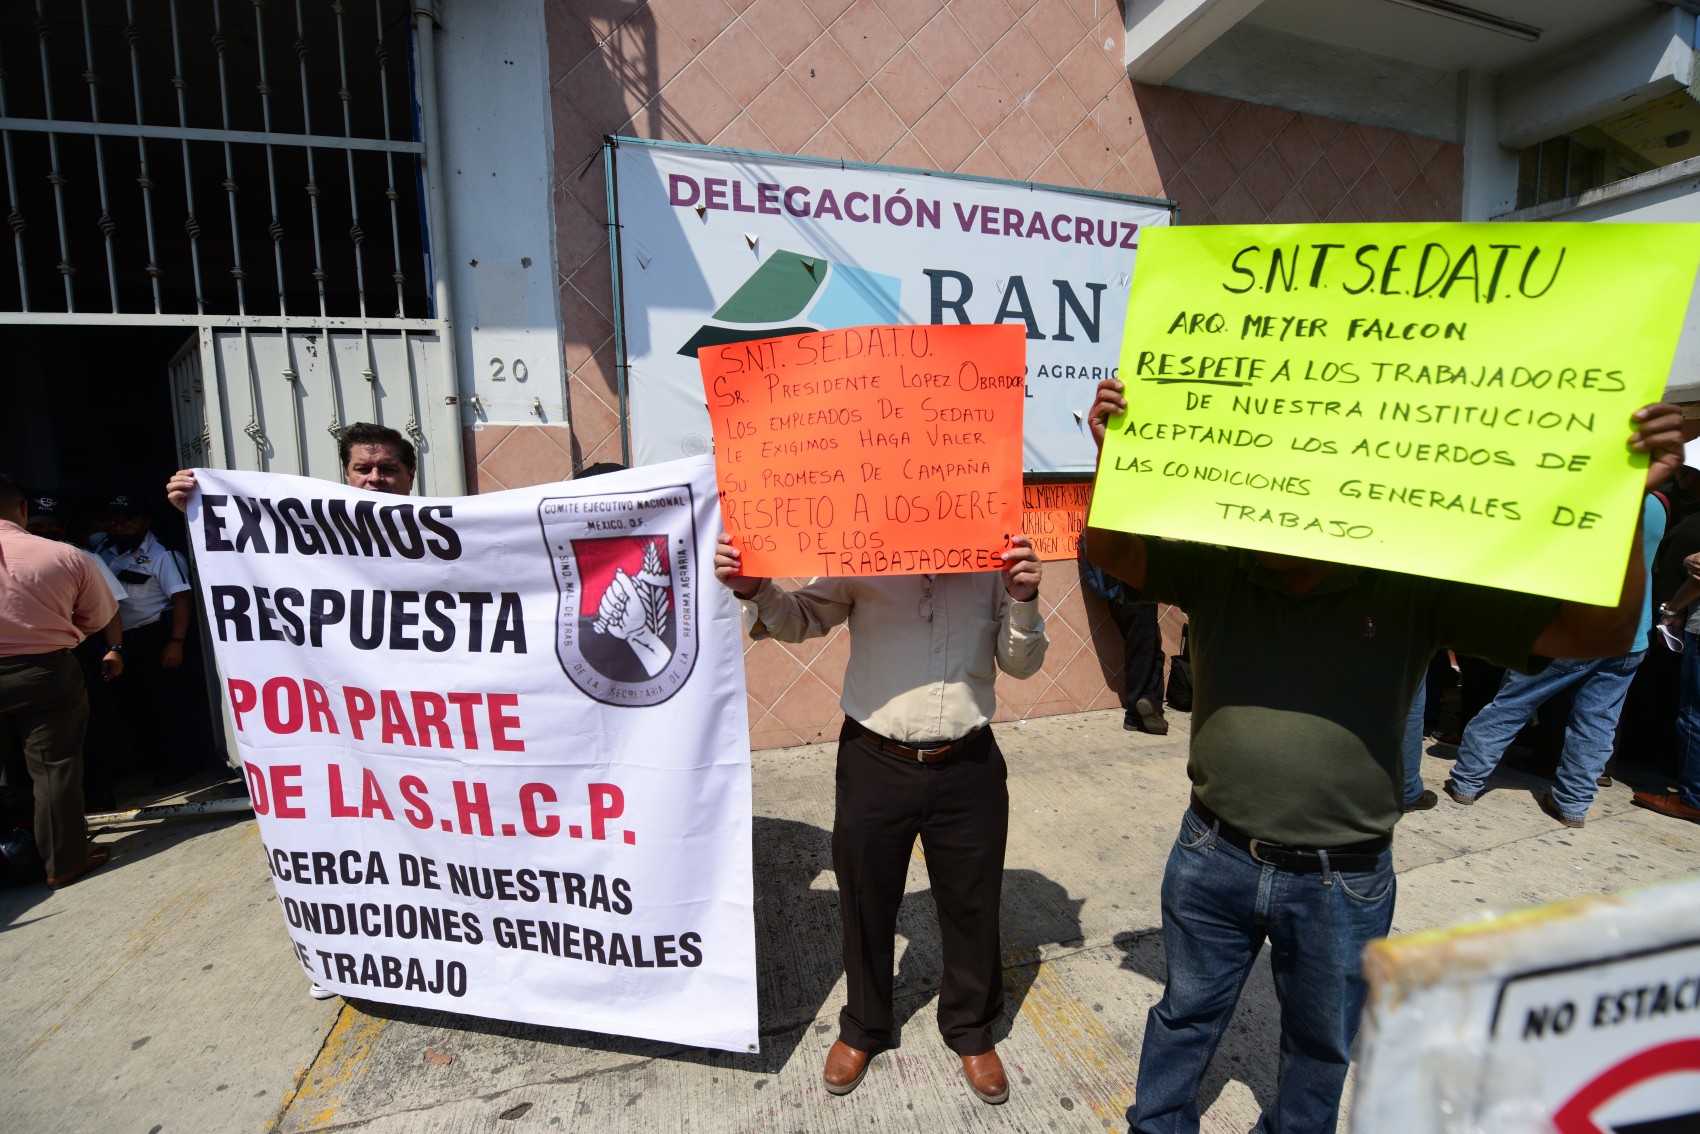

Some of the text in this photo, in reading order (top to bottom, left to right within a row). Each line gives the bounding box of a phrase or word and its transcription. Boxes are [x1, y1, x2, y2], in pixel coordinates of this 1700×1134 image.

[668, 174, 1139, 250] DELEGACIÓN VERACRUZ
[923, 268, 1107, 343] RAN
[1167, 311, 1467, 342] ARQ. MEYER FALCON
[490, 358, 527, 382] 20
[1136, 351, 1626, 391] RESPETE A LOS TRABAJADORES
[726, 418, 757, 440] LOS
[769, 408, 862, 430] EMPLEADOS
[1186, 391, 1595, 432] DE NUESTRA INSTITUCION
[727, 424, 985, 463] LE EXIGIMOS HAGA VALER
[1124, 421, 1591, 471] ACEPTANDO LOS ACUERDOS DE
[762, 468, 845, 488] PROMESA
[903, 459, 991, 481] CAMPAÑA
[1115, 456, 1603, 529] LAS CONDICIONES GENERALES DE
[544, 496, 686, 514] COMITE EJECUTIVO NACIONAL
[853, 493, 869, 523] A
[884, 495, 930, 523] LOS
[1216, 501, 1384, 543] TRABAJO.
[201, 494, 462, 561] EXIGIMOS
[798, 532, 828, 553] DE
[843, 531, 884, 550] LOS
[679, 549, 689, 590] AGRARIA
[210, 585, 527, 654] RESPUESTA
[564, 606, 573, 618] DE
[683, 591, 692, 637] REFORMA
[573, 663, 587, 676] DE
[668, 672, 681, 684] DE
[680, 652, 689, 665] LA
[587, 676, 599, 689] LA
[609, 682, 664, 699] SECRETARIA
[227, 676, 525, 752] POR PARTE
[244, 760, 636, 845] DE LA S.H.C.P.
[399, 852, 440, 890] DE
[447, 862, 633, 916] NUESTRAS
[278, 894, 703, 969] ONDICIONES GENERALES
[316, 950, 468, 998] TRABAJO
[1522, 1001, 1576, 1041] NO
